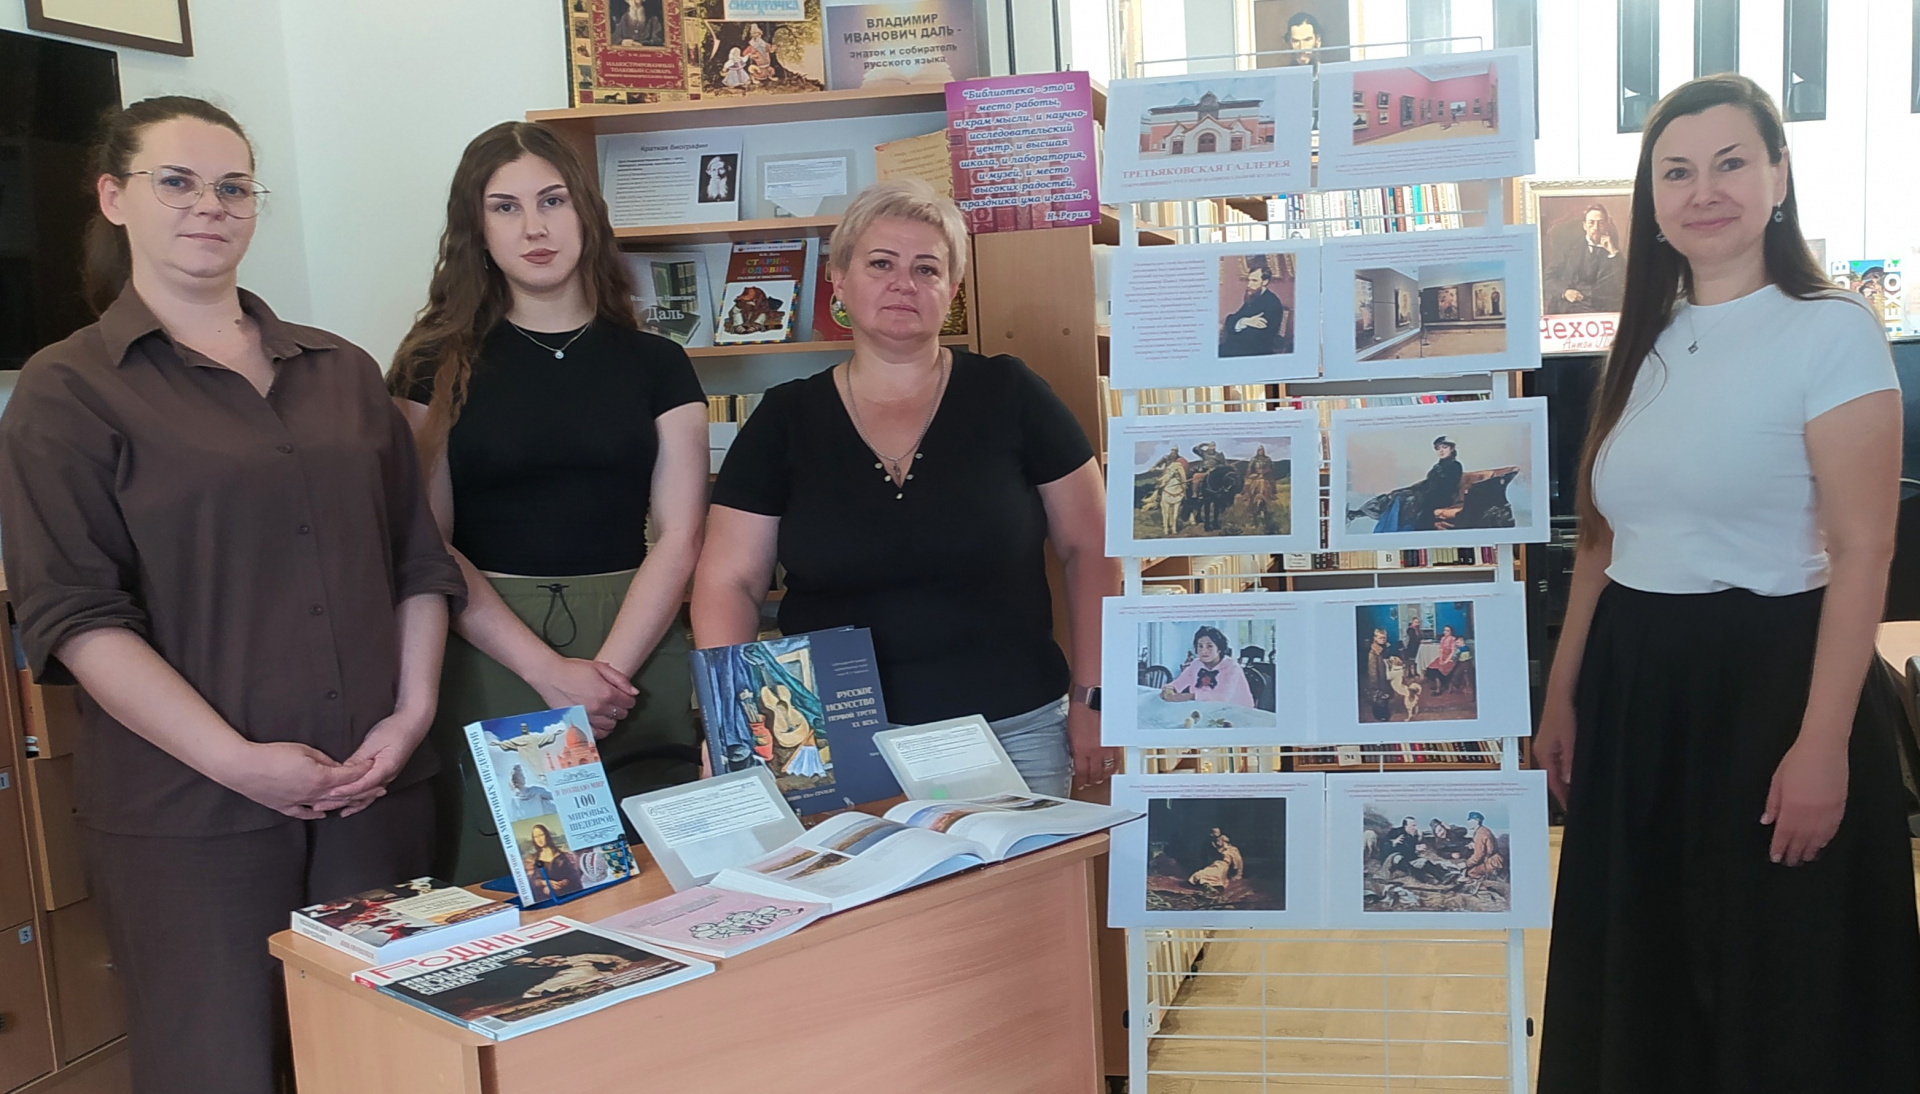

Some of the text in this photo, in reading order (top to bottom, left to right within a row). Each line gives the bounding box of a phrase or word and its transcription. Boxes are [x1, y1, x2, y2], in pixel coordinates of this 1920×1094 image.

[866, 13, 939, 29] ВЛАДИМИР
[844, 28, 917, 44] ИВАНОВИЧ
[921, 25, 955, 39] ДАЛЬ
[850, 49, 886, 58] знаток
[899, 44, 958, 55] собиратель
[863, 55, 947, 70] русского языка
[1042, 84, 1064, 92] это
[1066, 83, 1075, 91] и
[977, 99, 1060, 112] место работы,
[965, 118, 991, 129] храм
[994, 114, 1032, 124] мысли,
[1046, 110, 1087, 120] научно-
[969, 123, 1073, 140] исследовательский
[640, 143, 708, 153] Краткая биография
[975, 144, 1012, 155] центр,
[1026, 140, 1068, 148] высшая
[960, 160, 998, 168] школа,
[1011, 151, 1086, 164] лаборатория,
[988, 169, 1022, 180] музей,
[1035, 166, 1070, 175] место
[1122, 160, 1291, 180] ТРЕТЬЯКОВСКАЯ ГАЛЛЕРЕЯ
[974, 180, 1076, 194] высоких радостей,
[961, 198, 1017, 210] праздника
[1020, 196, 1041, 206] ума
[1047, 211, 1090, 221] Н. Рерих
[746, 258, 790, 266] СТАРИК-
[742, 266, 790, 274] ГОДОВИК
[646, 306, 685, 324] Даль
[1540, 318, 1616, 339] Чехов
[836, 686, 874, 699] РУССКОЕ
[826, 698, 875, 712] ИСКУССТВО
[828, 708, 878, 722] ПЕРВОЙ ТРЕТИ
[862, 718, 879, 726] ВЕКА
[468, 730, 493, 783] ШЕДЕВРОВ
[0, 776, 6, 788] 1
[486, 783, 508, 832] МИРОВЫХ
[574, 793, 596, 808] 100
[568, 806, 610, 821] МИРОВЫХ
[570, 814, 615, 832] ШЕДЕВРОВ
[502, 832, 514, 850] 100
[22, 930, 30, 942] 3
[397, 948, 530, 986] ИВАН ГРОЗНЫЙ
[428, 961, 505, 984] УБИВАЛ
